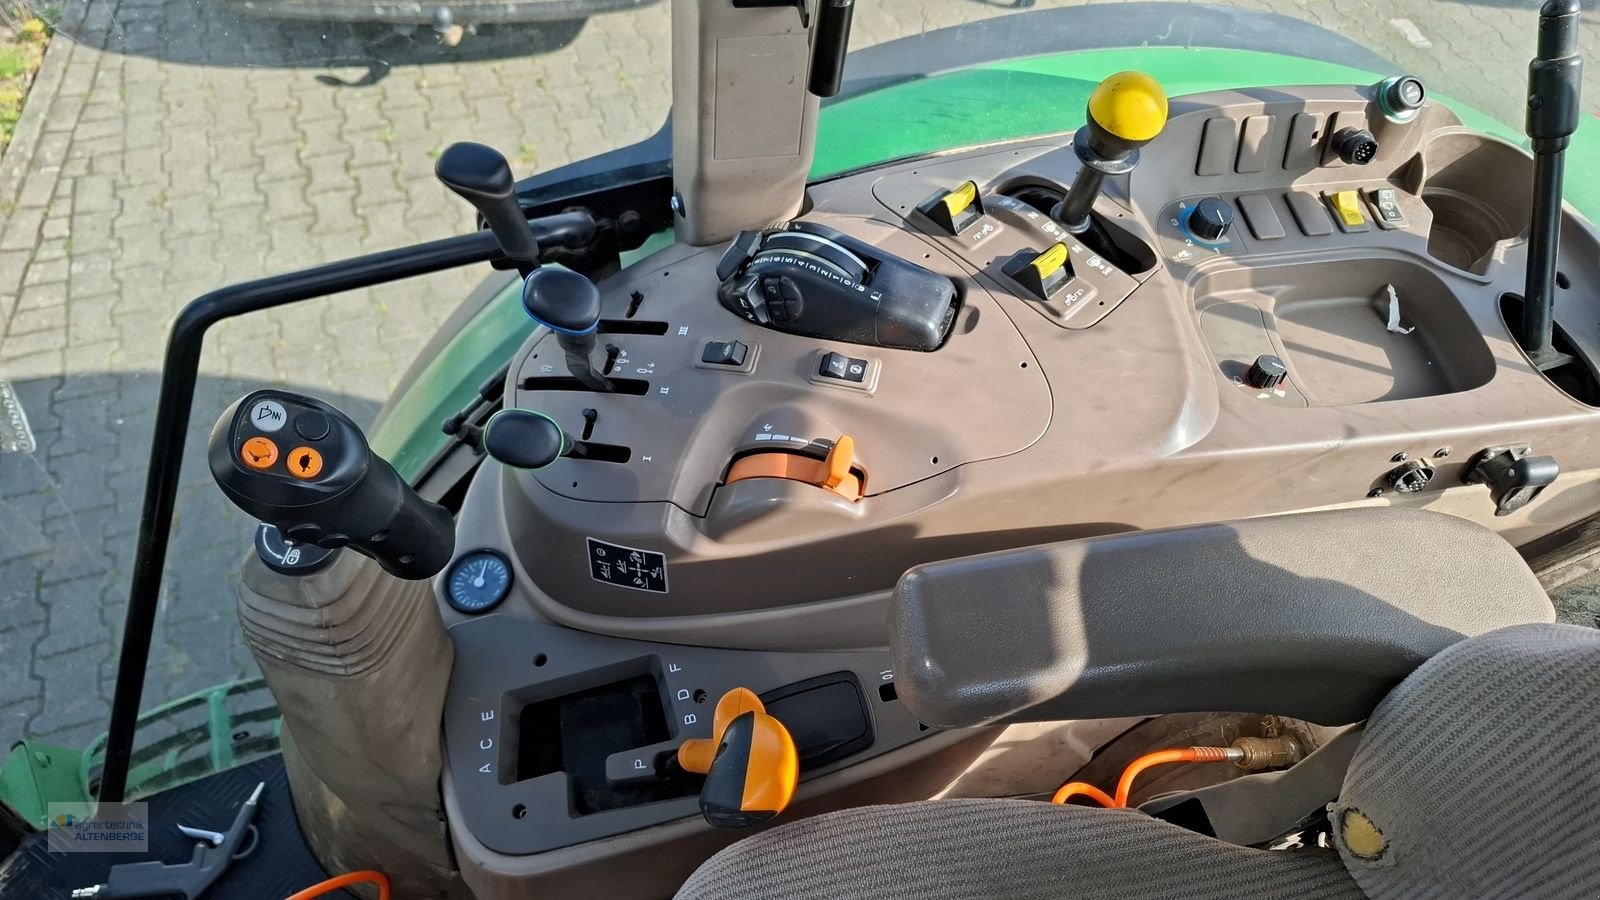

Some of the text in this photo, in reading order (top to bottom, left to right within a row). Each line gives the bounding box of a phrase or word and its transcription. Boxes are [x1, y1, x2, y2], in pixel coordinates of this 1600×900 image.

[1170, 218, 1179, 226] 3
[1185, 239, 1194, 247] 2
[669, 663, 682, 673] F
[677, 688, 690, 701] D
[481, 710, 495, 721] E
[684, 713, 697, 725] B
[480, 738, 493, 750] C
[479, 763, 491, 773] A
[634, 758, 647, 770] P
